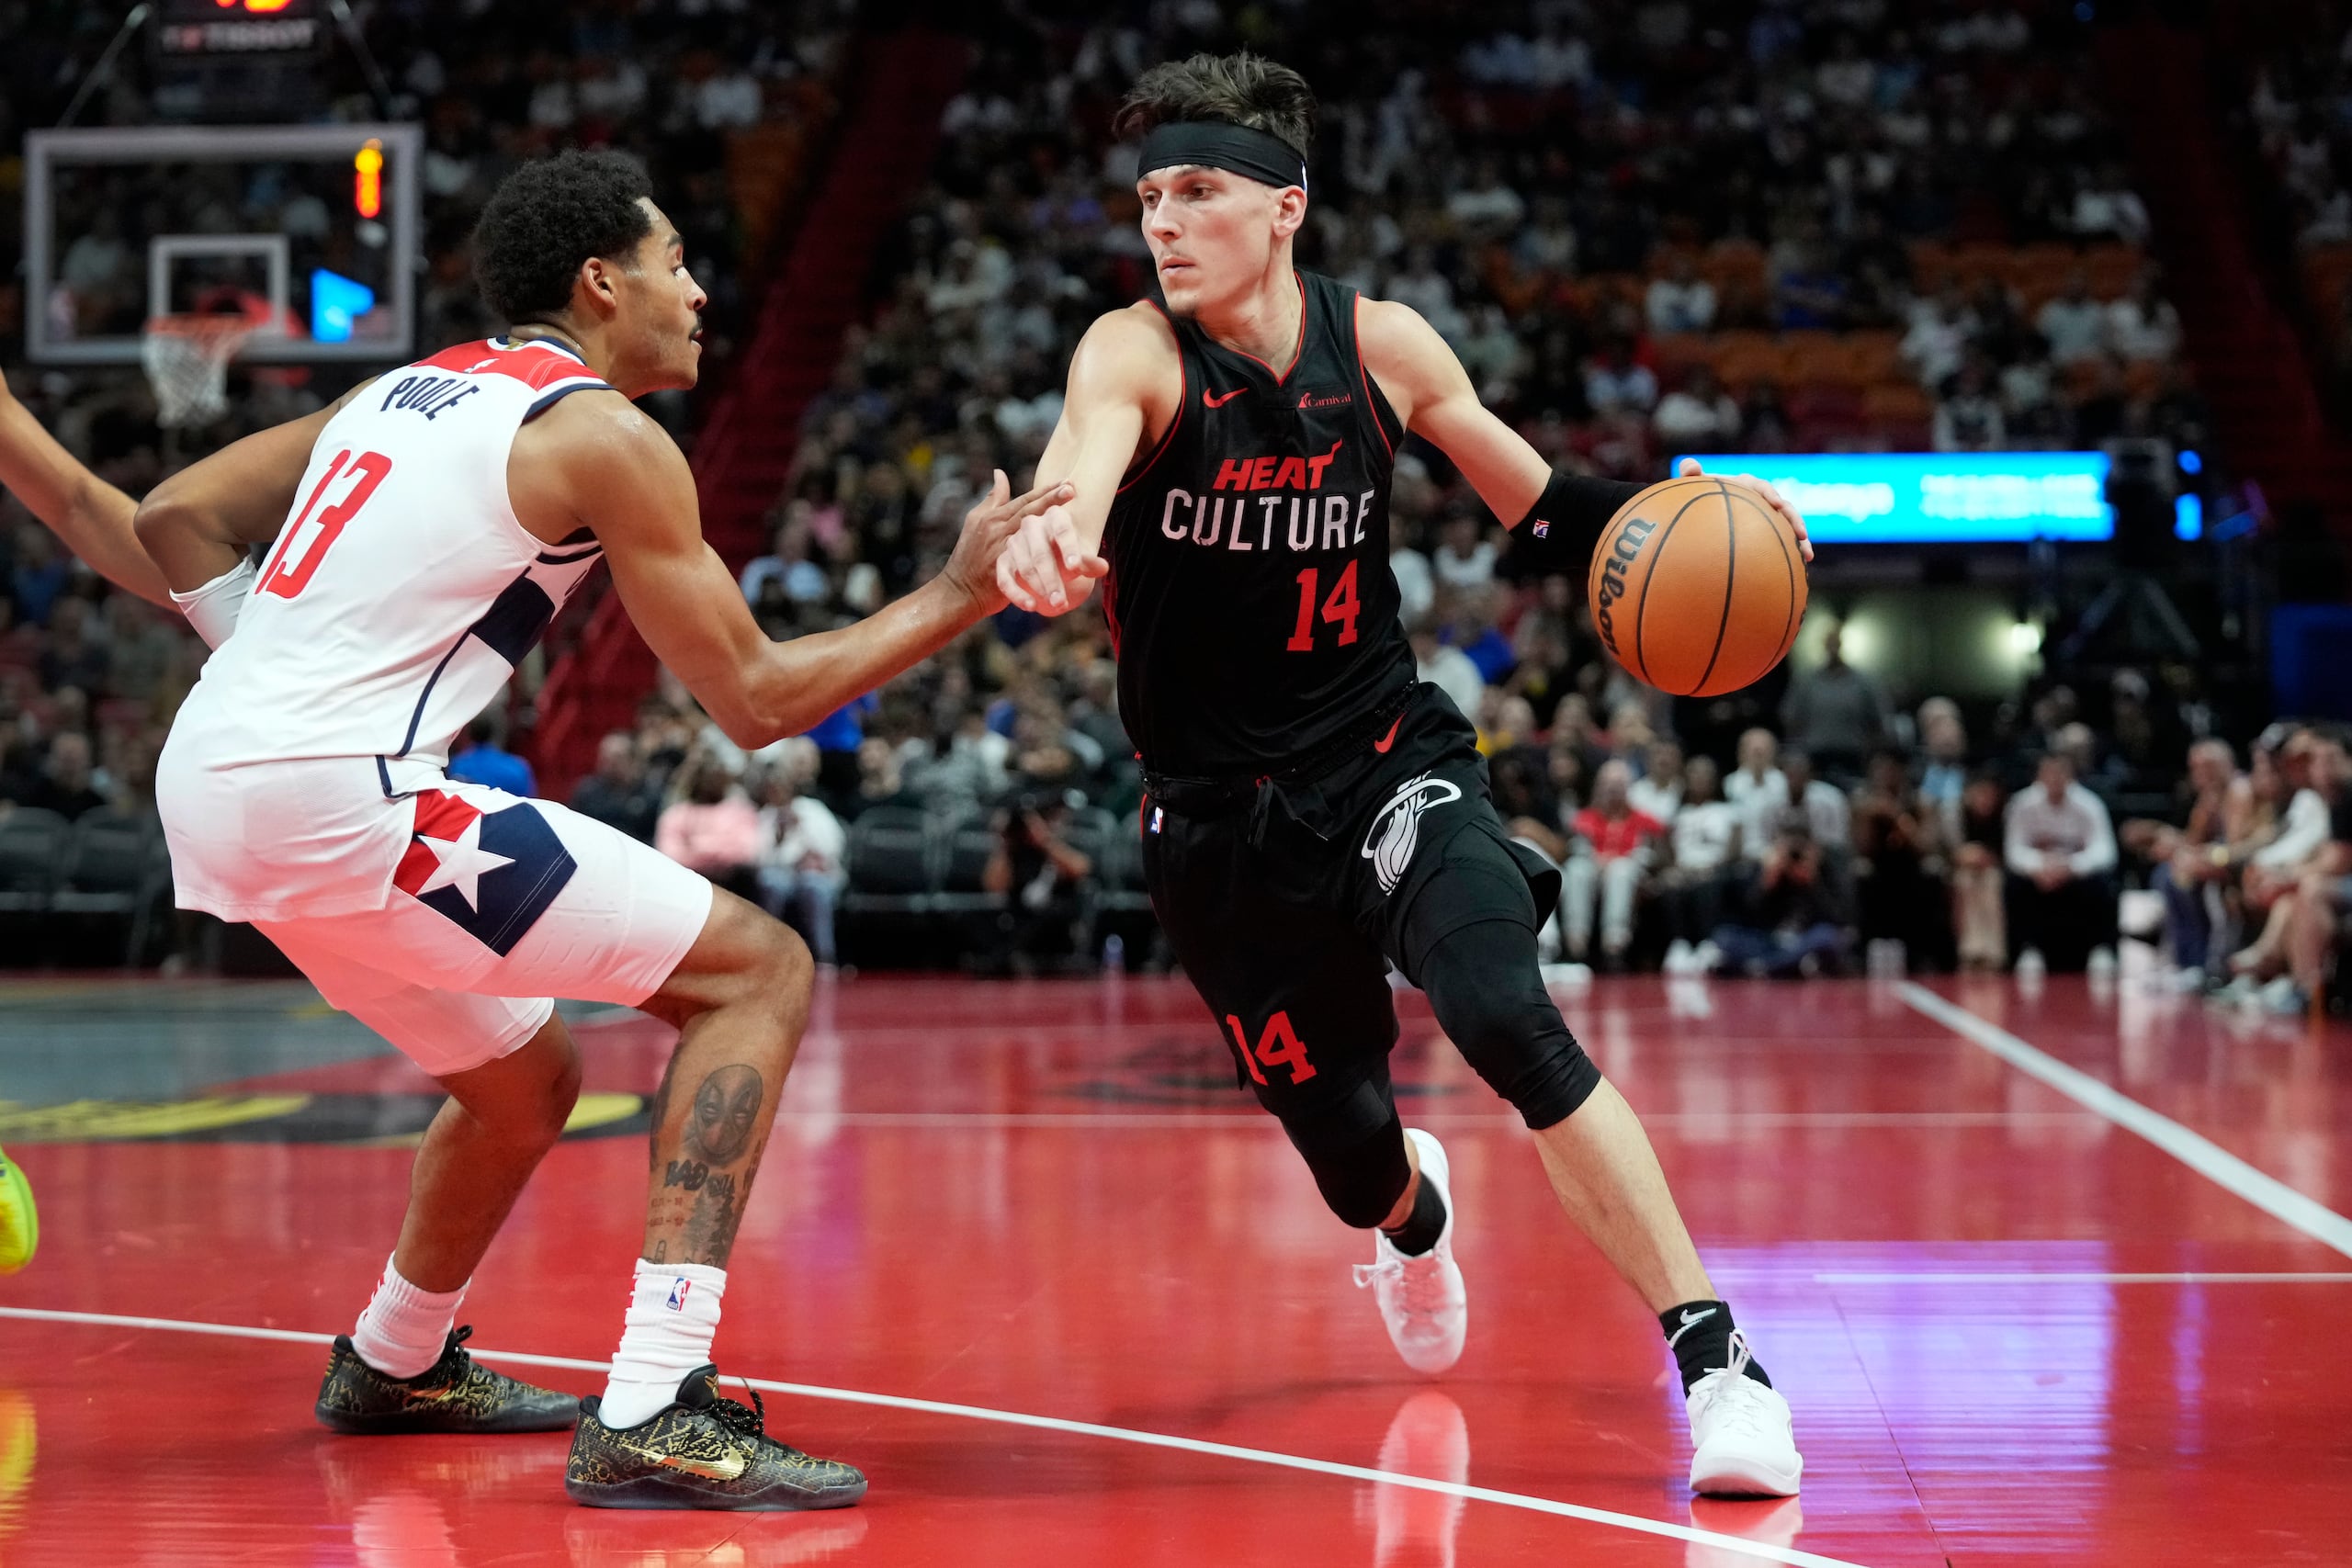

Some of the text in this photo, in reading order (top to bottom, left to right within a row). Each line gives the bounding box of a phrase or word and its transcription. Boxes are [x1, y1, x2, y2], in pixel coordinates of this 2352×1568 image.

[379, 376, 481, 422] POOLE
[1306, 392, 1351, 407] Carnival
[1212, 437, 1343, 491] HEAT
[254, 448, 393, 599] 13
[1160, 488, 1375, 552] CULTURE
[1285, 558, 1361, 651] 14
[1598, 516, 1657, 656] Wilson
